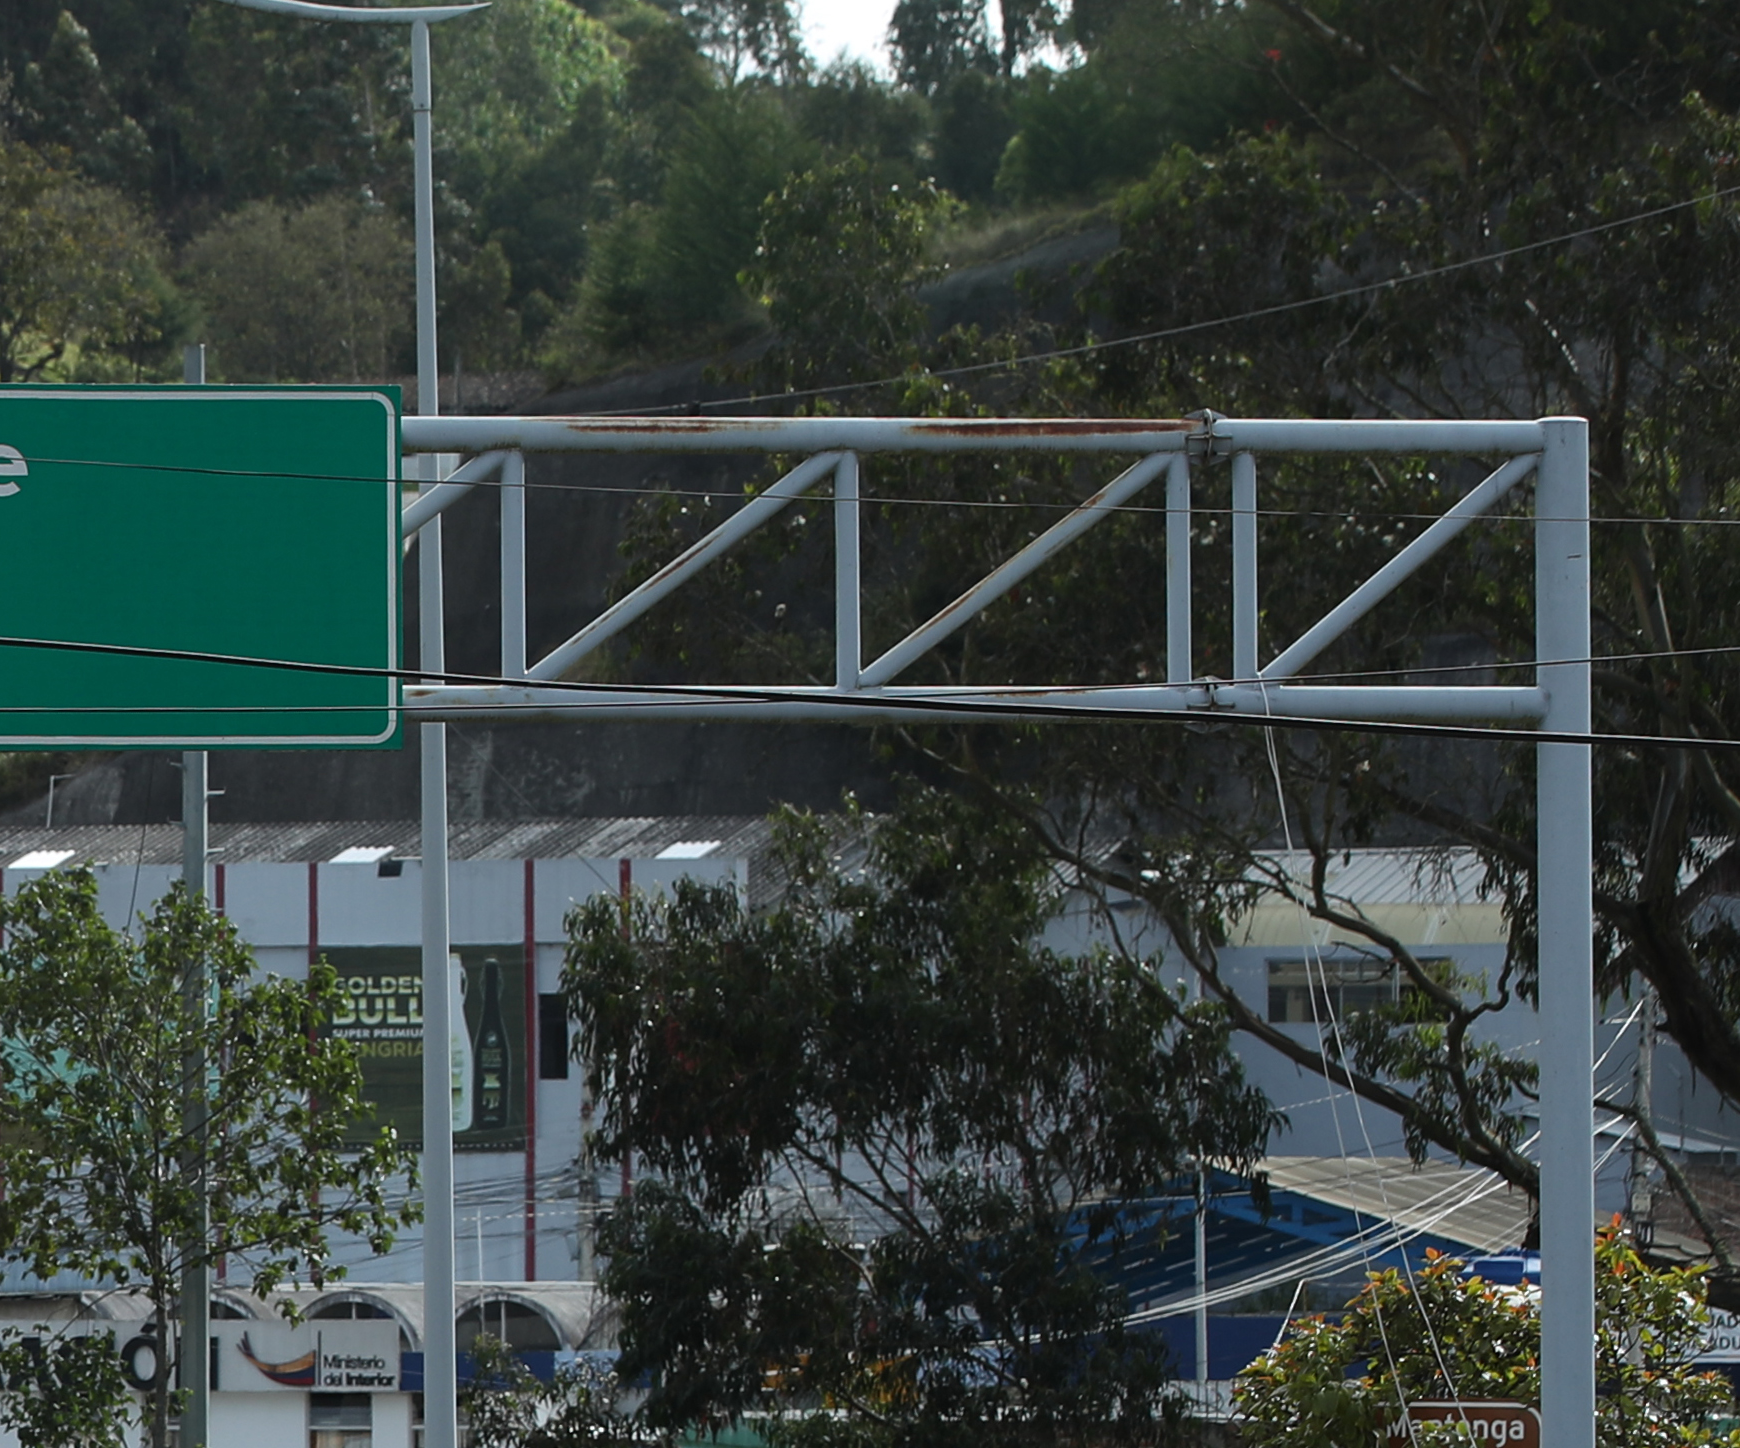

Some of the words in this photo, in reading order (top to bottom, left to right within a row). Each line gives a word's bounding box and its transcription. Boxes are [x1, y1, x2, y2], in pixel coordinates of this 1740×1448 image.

[323, 1354, 386, 1371] Ministerio
[323, 1372, 343, 1386] del
[345, 1372, 396, 1387] Interior
